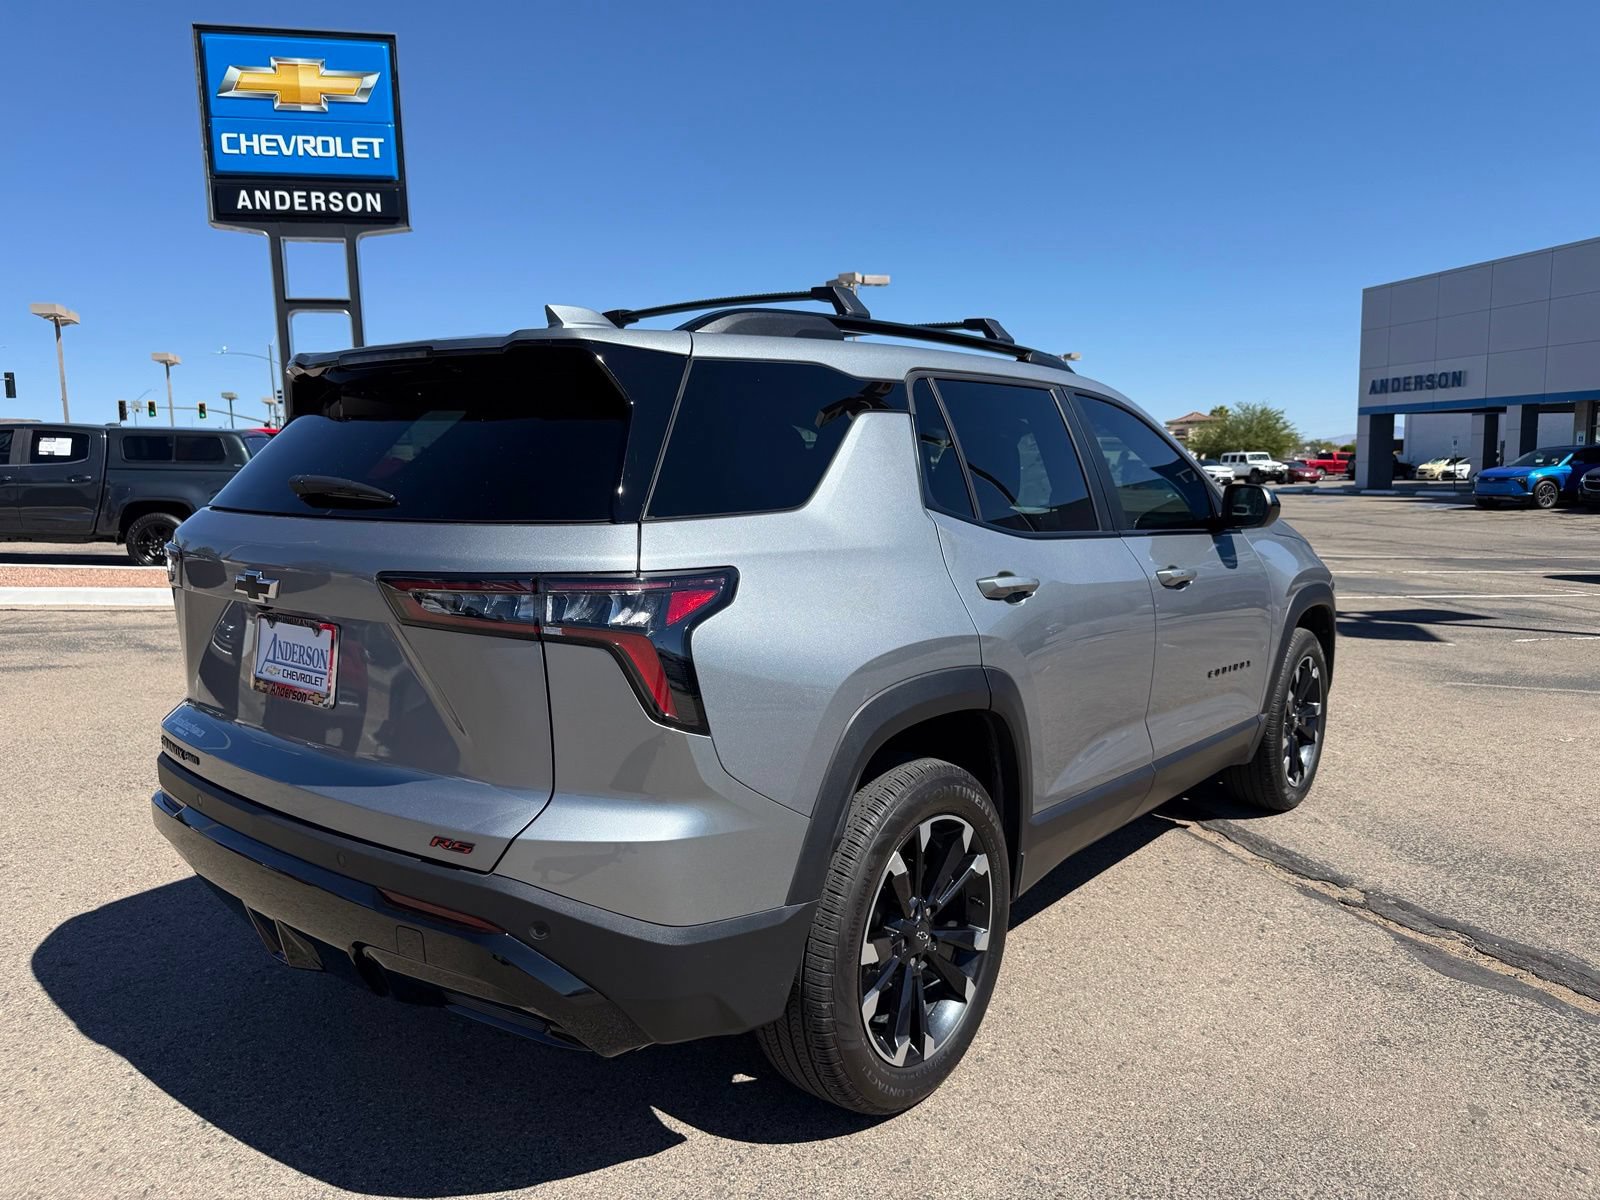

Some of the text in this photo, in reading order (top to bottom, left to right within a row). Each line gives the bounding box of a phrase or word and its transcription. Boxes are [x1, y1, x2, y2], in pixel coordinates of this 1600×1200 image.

[221, 133, 384, 159] CHEVROLET
[236, 189, 382, 213] ANDERSON
[1369, 370, 1464, 395] ANDERSON
[258, 633, 328, 674] ANDERSON
[281, 668, 324, 687] CHEVROLET
[270, 681, 308, 703] Anderson
[429, 835, 475, 855] RS
